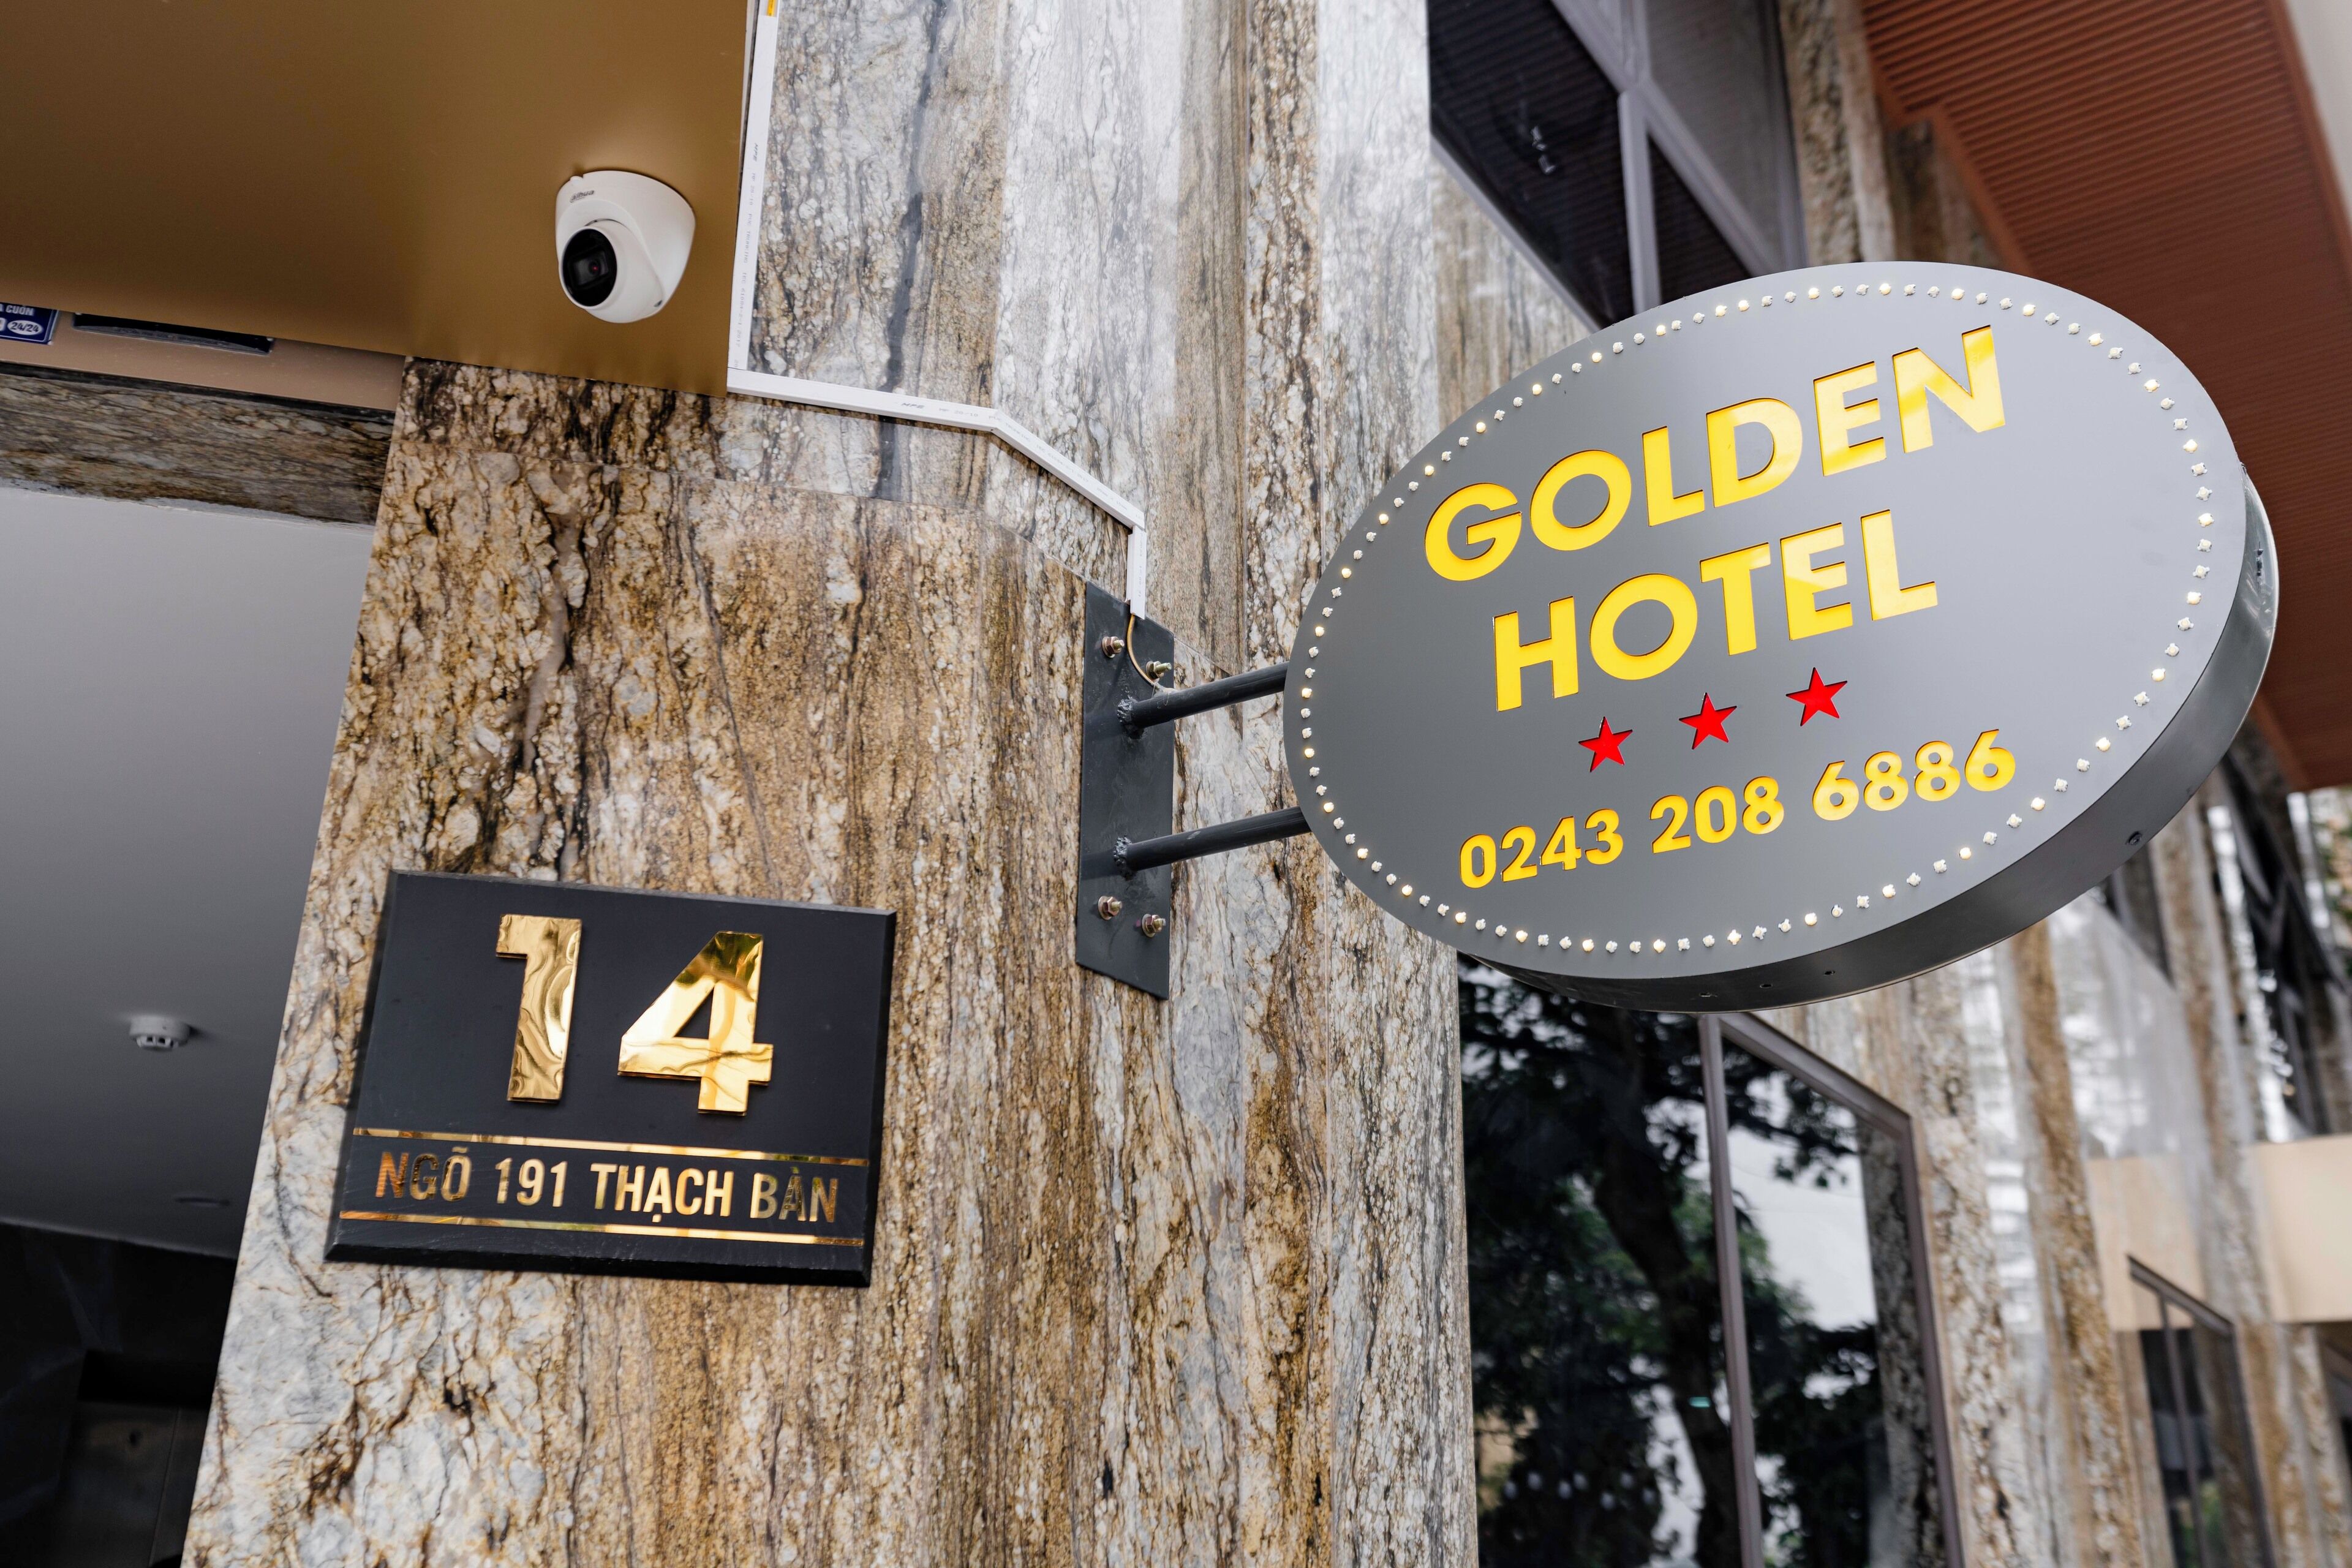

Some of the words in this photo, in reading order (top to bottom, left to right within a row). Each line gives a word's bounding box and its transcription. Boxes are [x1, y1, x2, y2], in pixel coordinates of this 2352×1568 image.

[10, 322, 39, 333] 24/24
[1424, 325, 2005, 582] GOLDEN
[1493, 510, 1937, 712] HOTEL
[1459, 809, 1624, 889] 0243
[1650, 775, 1785, 854] 208
[1811, 729, 2016, 821] 6886
[495, 913, 774, 1116] 14
[375, 1146, 472, 1202] NGÕ
[494, 1156, 568, 1207] 191
[590, 1162, 735, 1223] THẠCH
